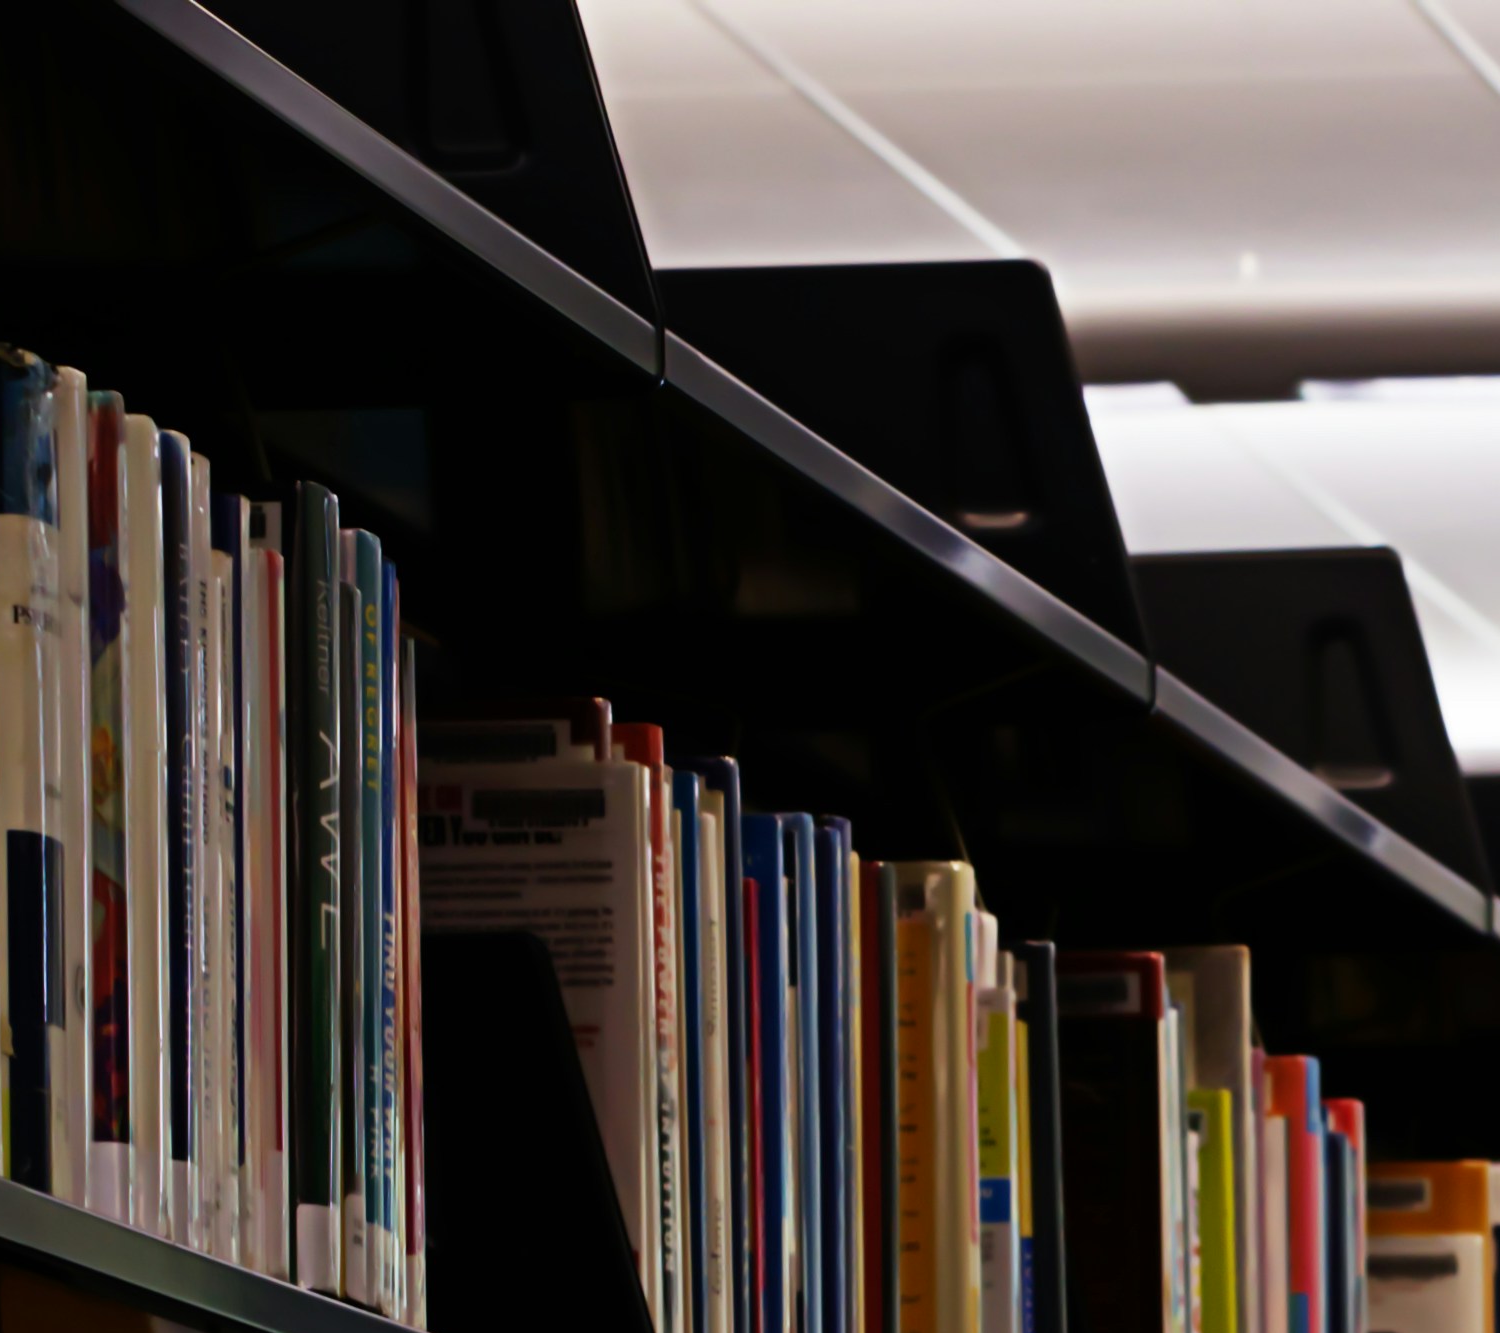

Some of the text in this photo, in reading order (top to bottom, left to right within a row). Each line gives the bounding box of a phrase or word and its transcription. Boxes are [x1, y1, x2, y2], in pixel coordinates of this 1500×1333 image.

[316, 578, 340, 954] Keltner AWE
[366, 662, 379, 793] REGRET
[655, 854, 667, 911] THE
[383, 911, 396, 1182] FIND YOUR WAY
[657, 925, 670, 1037] POWER
[370, 1106, 381, 1182] PINK
[660, 1102, 675, 1274] INTUITION
